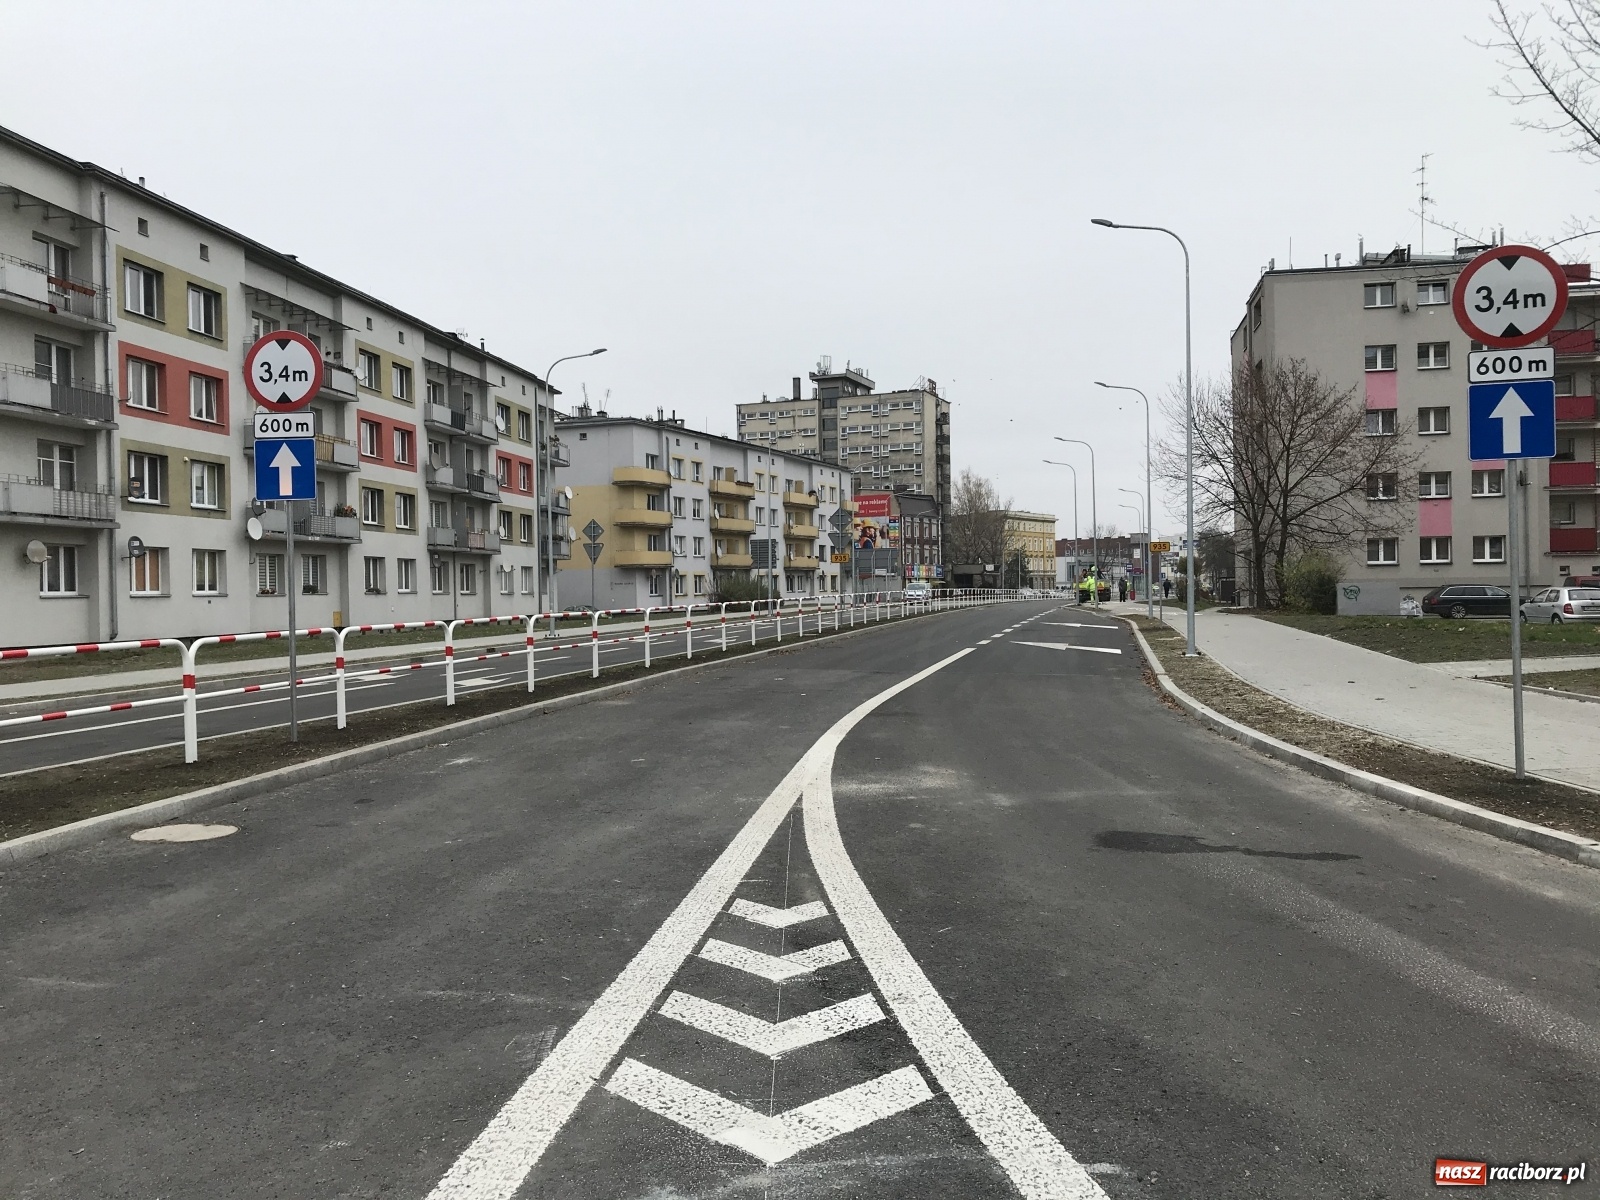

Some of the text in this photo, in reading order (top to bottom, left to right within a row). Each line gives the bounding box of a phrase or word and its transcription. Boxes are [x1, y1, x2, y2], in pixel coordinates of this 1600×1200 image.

[1474, 286, 1546, 314] 3,4m
[259, 361, 308, 385] 3,4m
[1476, 355, 1547, 375] 600 m
[259, 418, 309, 433] 600 m
